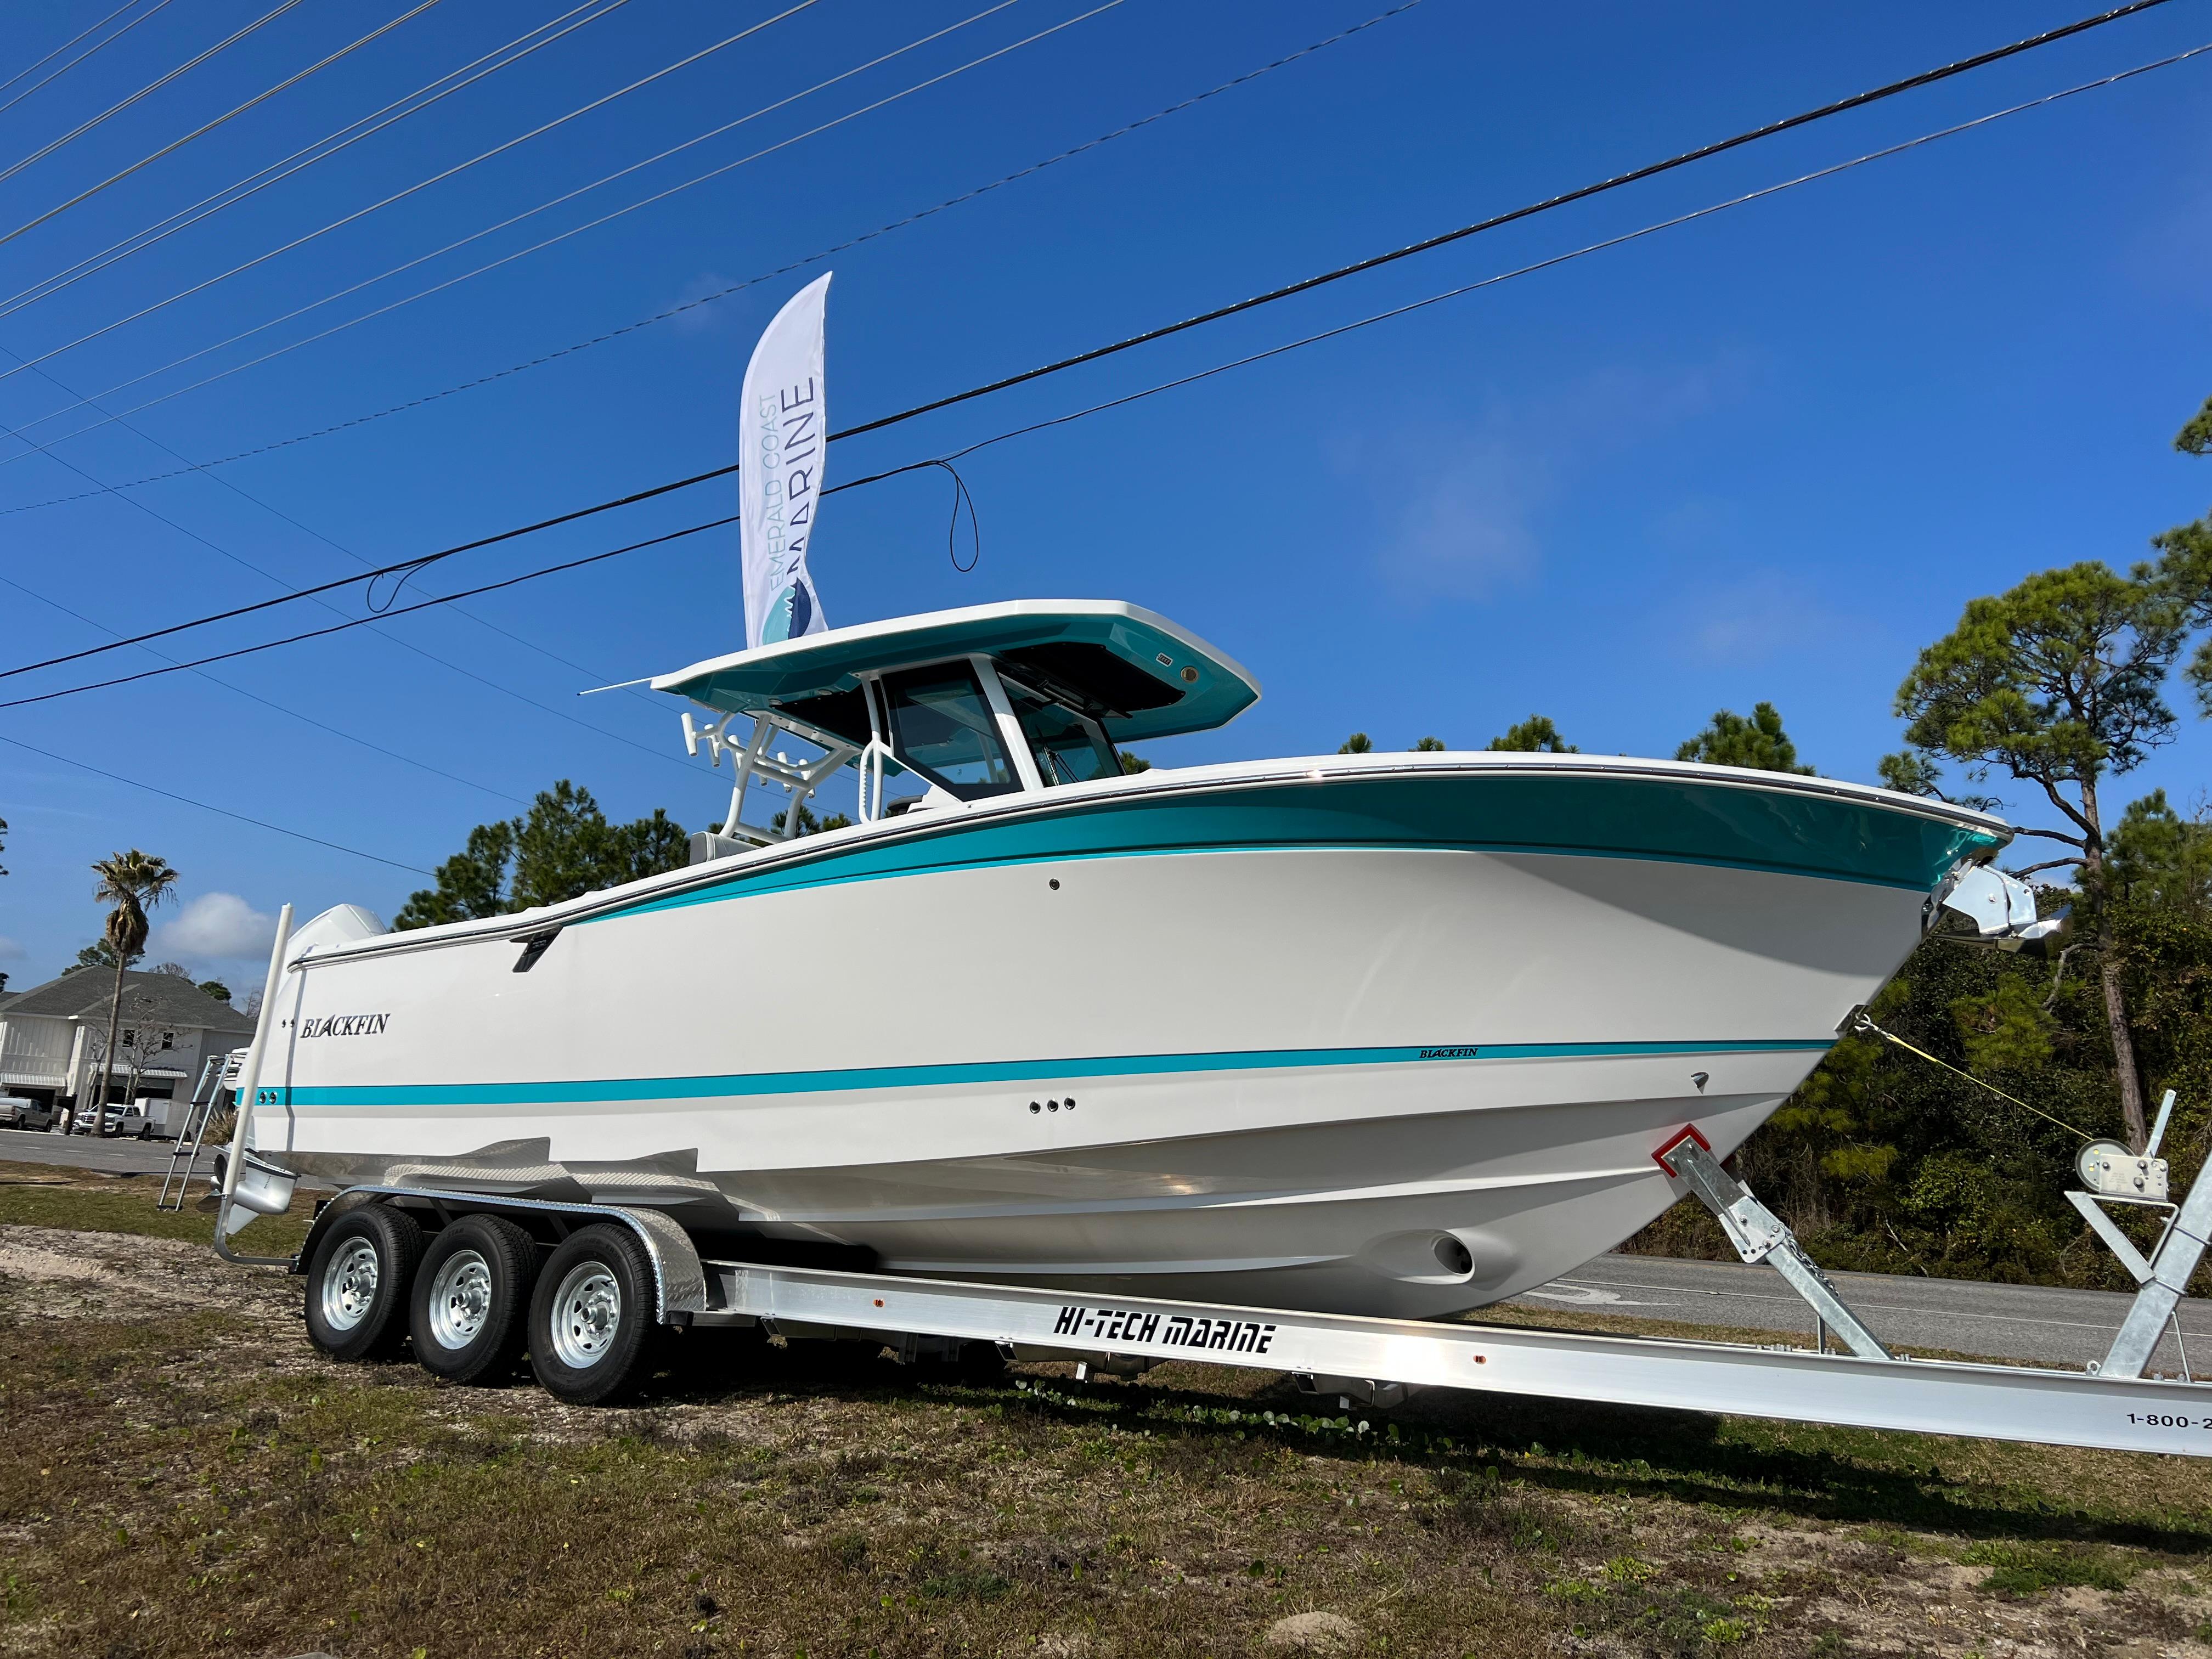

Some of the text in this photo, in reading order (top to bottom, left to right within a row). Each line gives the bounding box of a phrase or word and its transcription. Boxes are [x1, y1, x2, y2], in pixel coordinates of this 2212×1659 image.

[759, 394, 786, 591] EMERALD COAST
[300, 1013, 391, 1039] BLACKFIN
[1419, 1048, 1479, 1058] BLACKFIN
[1053, 1306, 1277, 1354] HI-TECH MARINE
